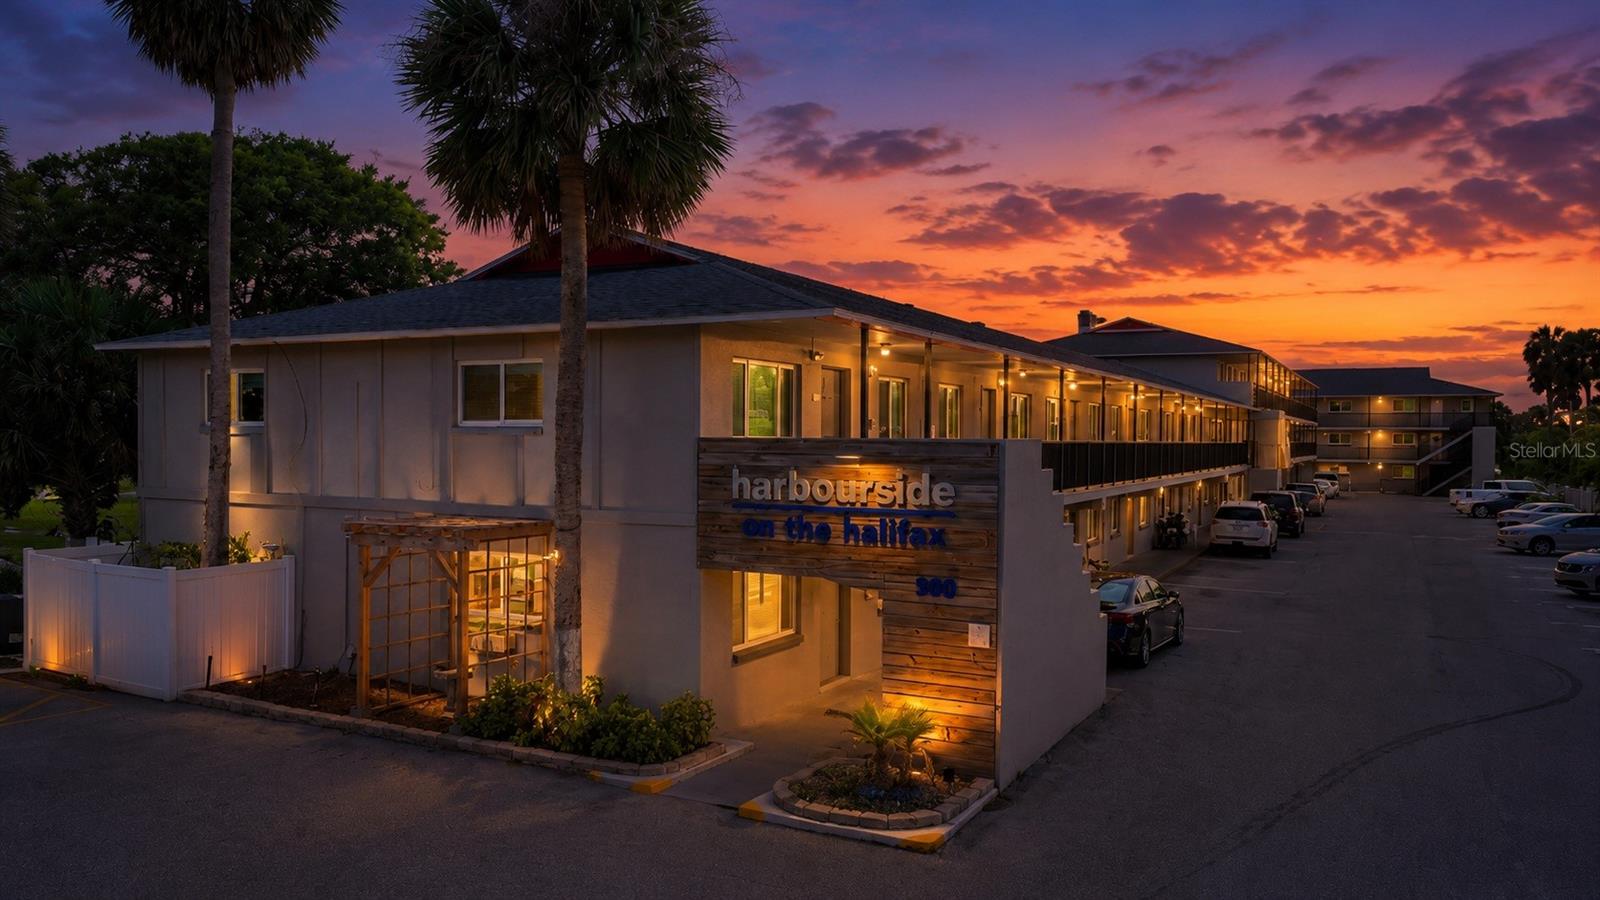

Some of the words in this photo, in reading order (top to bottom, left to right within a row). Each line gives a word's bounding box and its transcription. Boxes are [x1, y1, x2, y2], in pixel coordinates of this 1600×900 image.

[731, 464, 956, 507] harbourside
[741, 517, 775, 539] on
[784, 515, 833, 543] the
[843, 512, 947, 548] halifax
